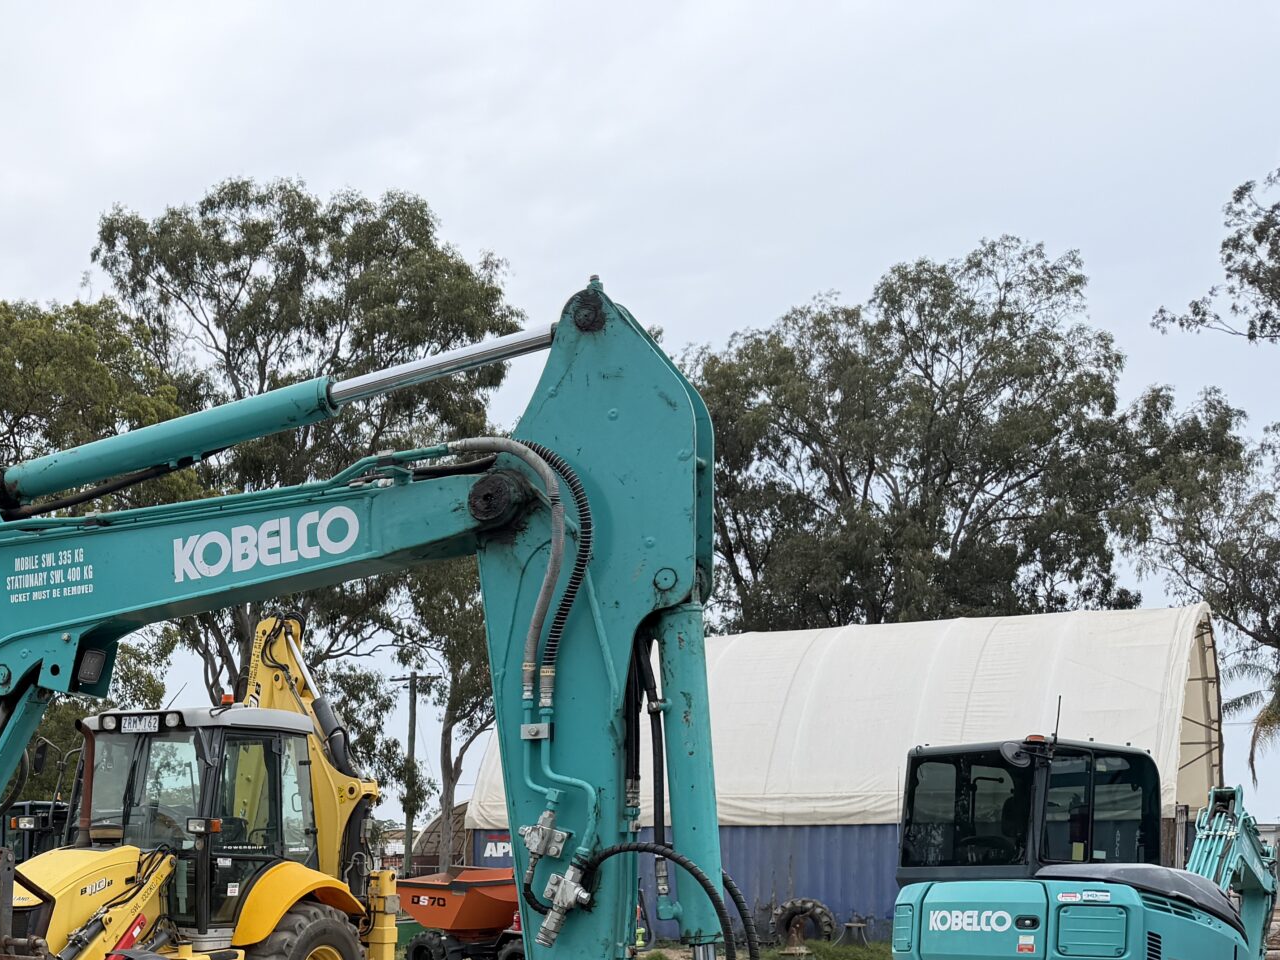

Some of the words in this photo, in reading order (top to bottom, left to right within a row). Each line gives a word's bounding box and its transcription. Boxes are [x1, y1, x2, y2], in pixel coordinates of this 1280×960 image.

[173, 505, 360, 584] KOBELCO
[14, 555, 39, 572] MOBILE
[41, 552, 56, 568] SWL
[58, 549, 72, 566] 335
[74, 548, 84, 563] KG
[6, 571, 47, 590] STATIONARY
[49, 569, 65, 585] SWL
[67, 567, 81, 582] 400
[83, 565, 93, 580] KG
[32, 589, 50, 601] MUST
[52, 588, 61, 598] BE
[63, 584, 94, 597] REMOVED
[411, 895, 446, 907] DS70
[928, 910, 1012, 932] KOBELCO
